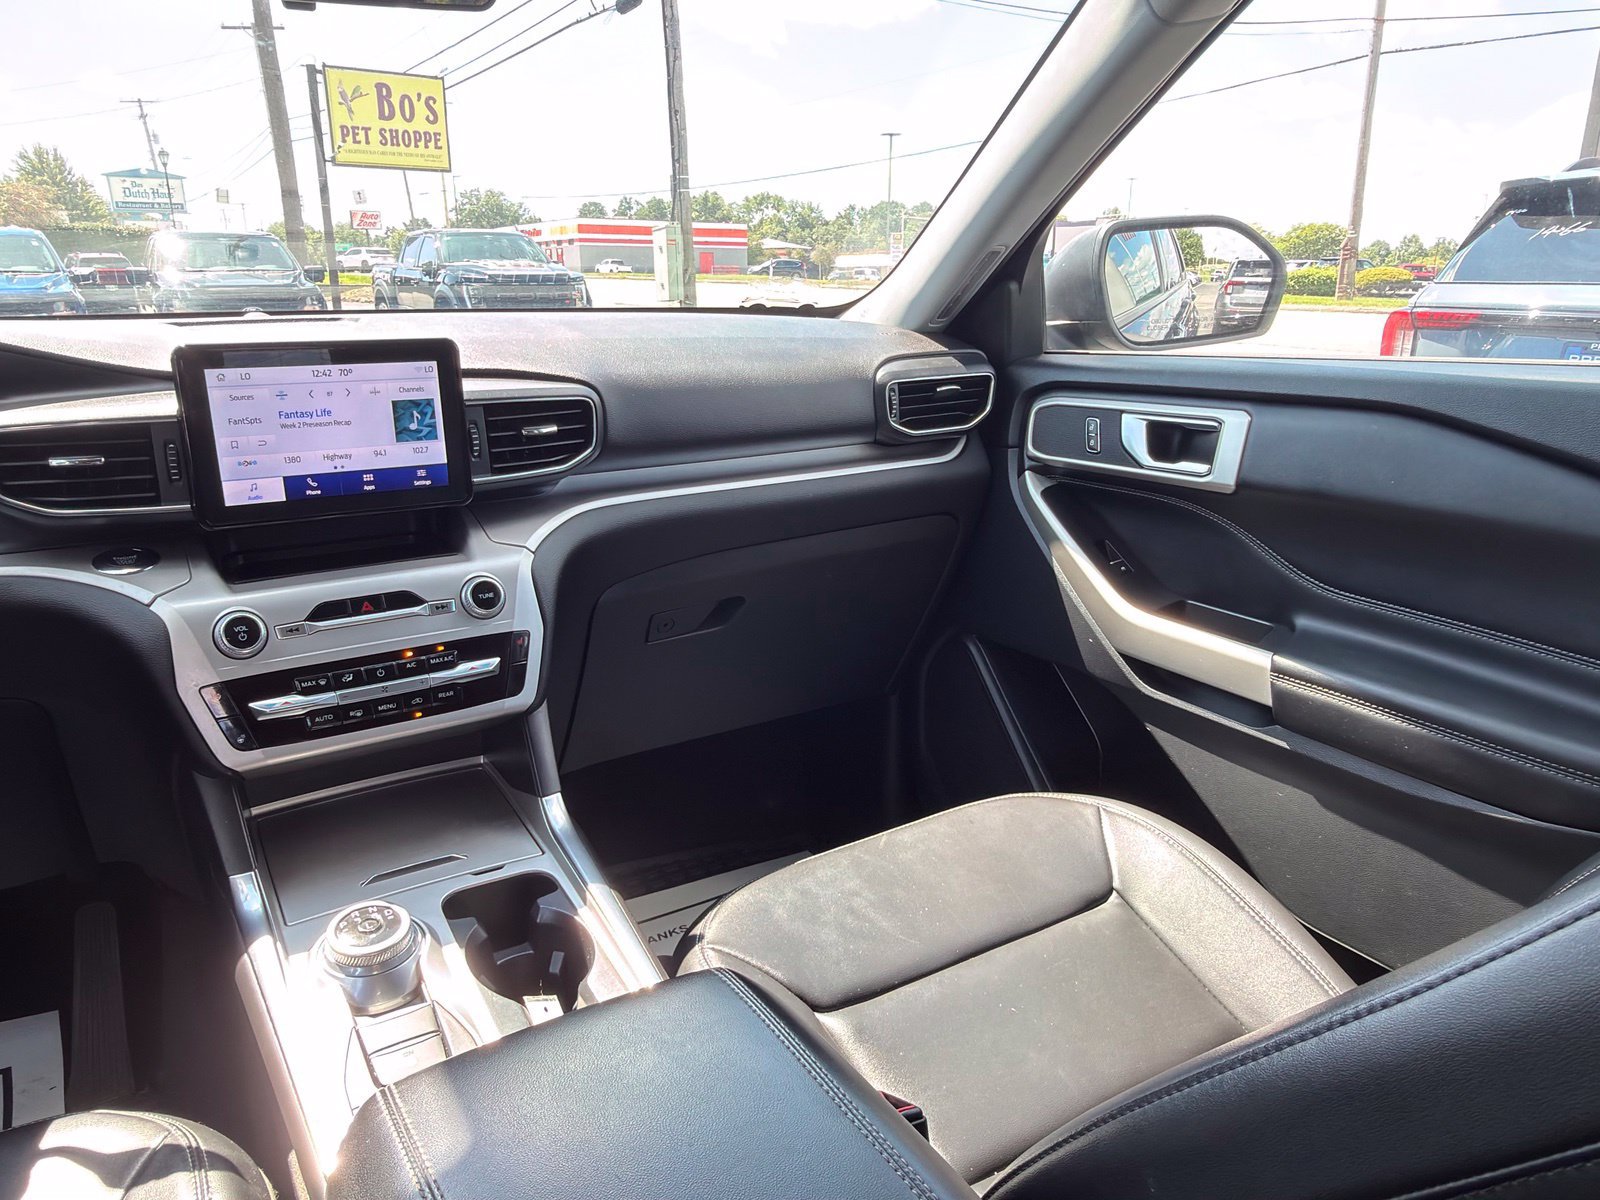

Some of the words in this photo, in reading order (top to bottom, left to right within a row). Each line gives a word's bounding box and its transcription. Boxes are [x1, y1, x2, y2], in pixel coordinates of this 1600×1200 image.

[340, 125, 371, 145] PET
[379, 128, 443, 150] SHOPPE
[121, 187, 150, 200] Dutch
[150, 188, 174, 200] Haus
[118, 201, 152, 209] Restaurant
[360, 212, 379, 220] Auto
[357, 219, 377, 227] Zone
[312, 369, 332, 377] 12:42
[229, 394, 254, 402] Sources
[278, 409, 314, 419] Fantasy
[315, 408, 332, 418] Life
[228, 416, 262, 426] FantSpts
[280, 422, 296, 430] Week
[297, 421, 302, 429] 2
[302, 419, 333, 428] Preseason
[333, 419, 352, 427] Recap
[373, 449, 387, 457] 94.1
[412, 446, 429, 454] 102.7
[283, 456, 301, 464] 1380
[323, 453, 352, 462] Highway
[430, 656, 444, 665] MAX
[406, 661, 417, 669] A/C
[301, 680, 316, 688] MAX
[438, 690, 454, 698] REAR
[378, 703, 397, 711] MENU
[315, 714, 334, 722] AUTO
